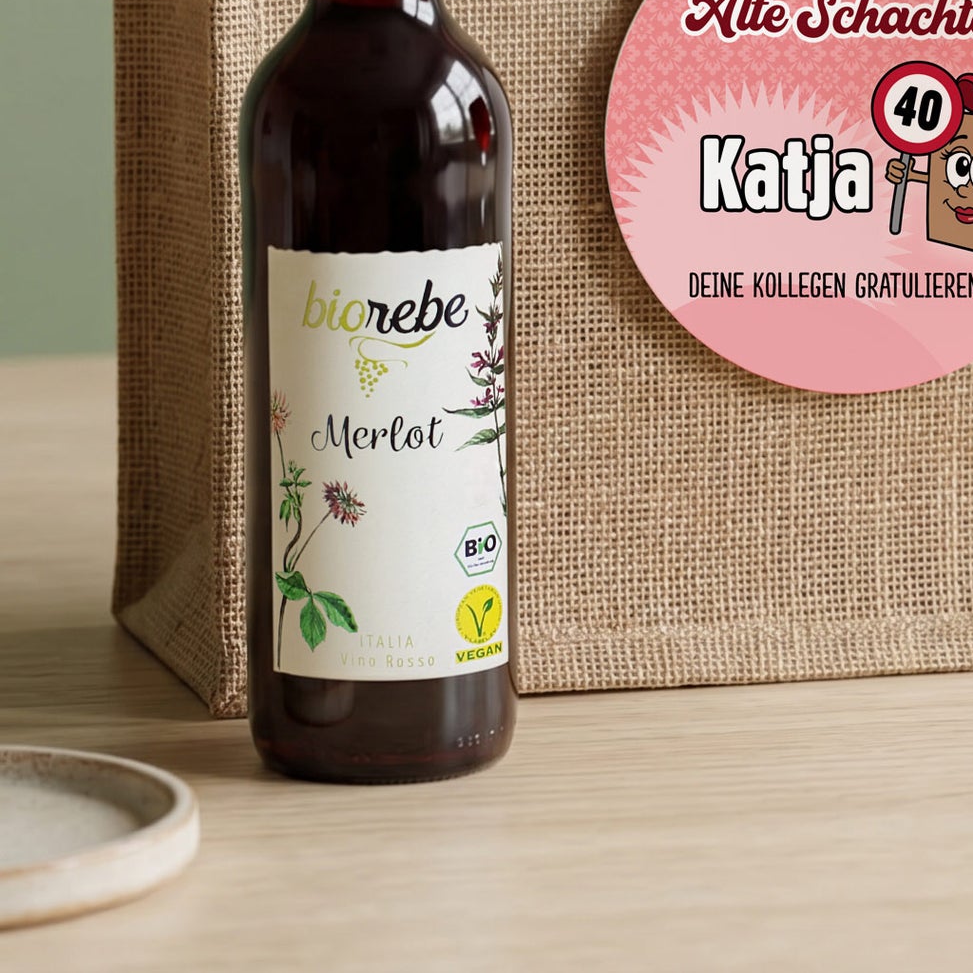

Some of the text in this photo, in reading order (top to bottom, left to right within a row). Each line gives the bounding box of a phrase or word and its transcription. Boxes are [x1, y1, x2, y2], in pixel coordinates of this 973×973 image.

[893, 85, 943, 132] 40
[700, 134, 873, 220] Katja
[688, 272, 745, 299] DEINE
[753, 272, 847, 299] KOLLEGEN
[302, 279, 469, 334] biorebe
[311, 414, 444, 459] Merlot
[360, 634, 414, 649] ITALIA
[456, 642, 503, 663] VEGAN
[340, 652, 435, 668] Vino Rosso
